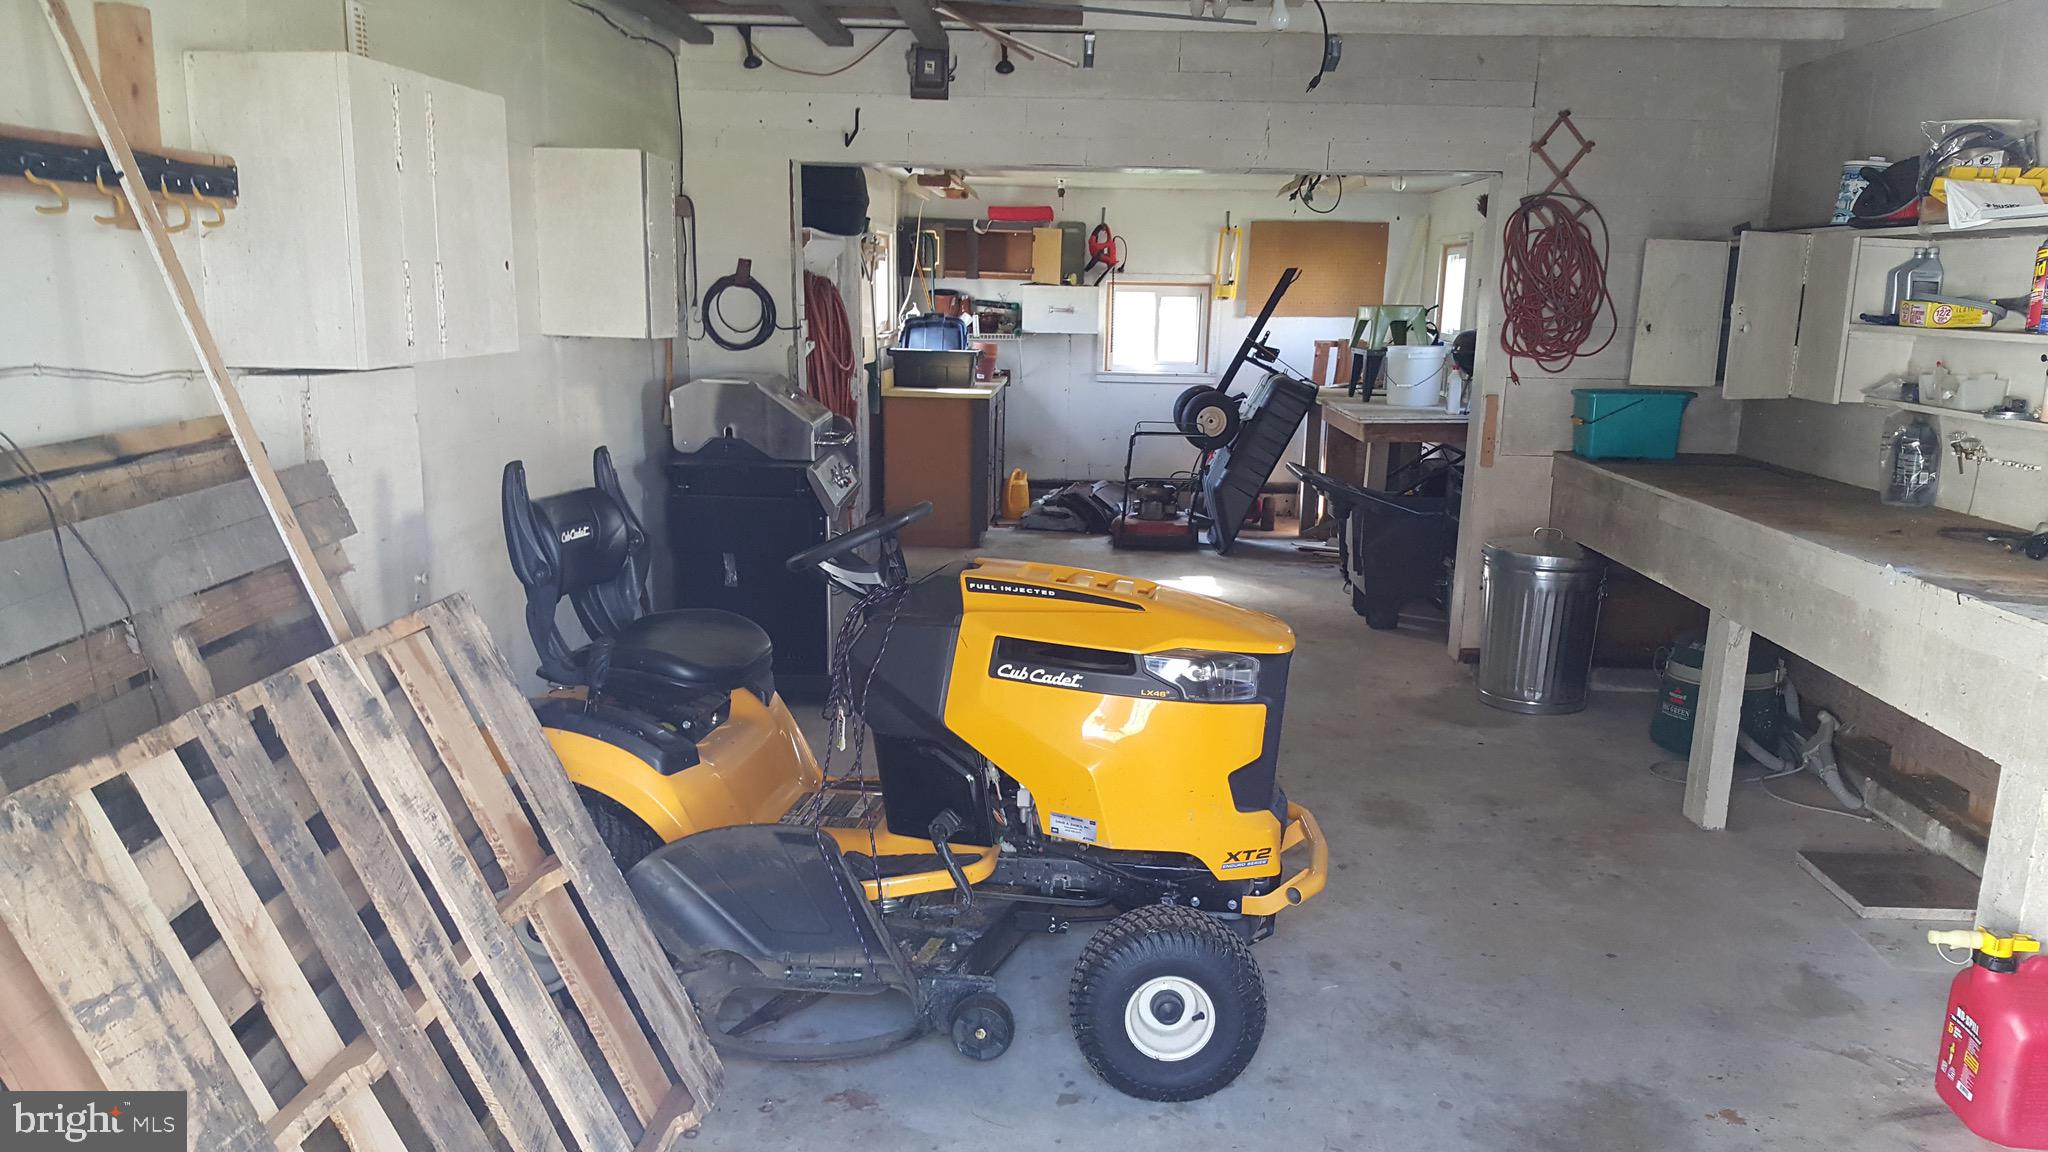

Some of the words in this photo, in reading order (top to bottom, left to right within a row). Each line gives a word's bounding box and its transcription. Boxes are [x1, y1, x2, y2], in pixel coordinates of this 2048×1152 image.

[969, 583, 997, 591] FUEL
[1000, 586, 1055, 596] INJECTED
[997, 664, 1028, 680] Cub
[1029, 669, 1084, 688] Cadet
[1223, 847, 1272, 863] XT2
